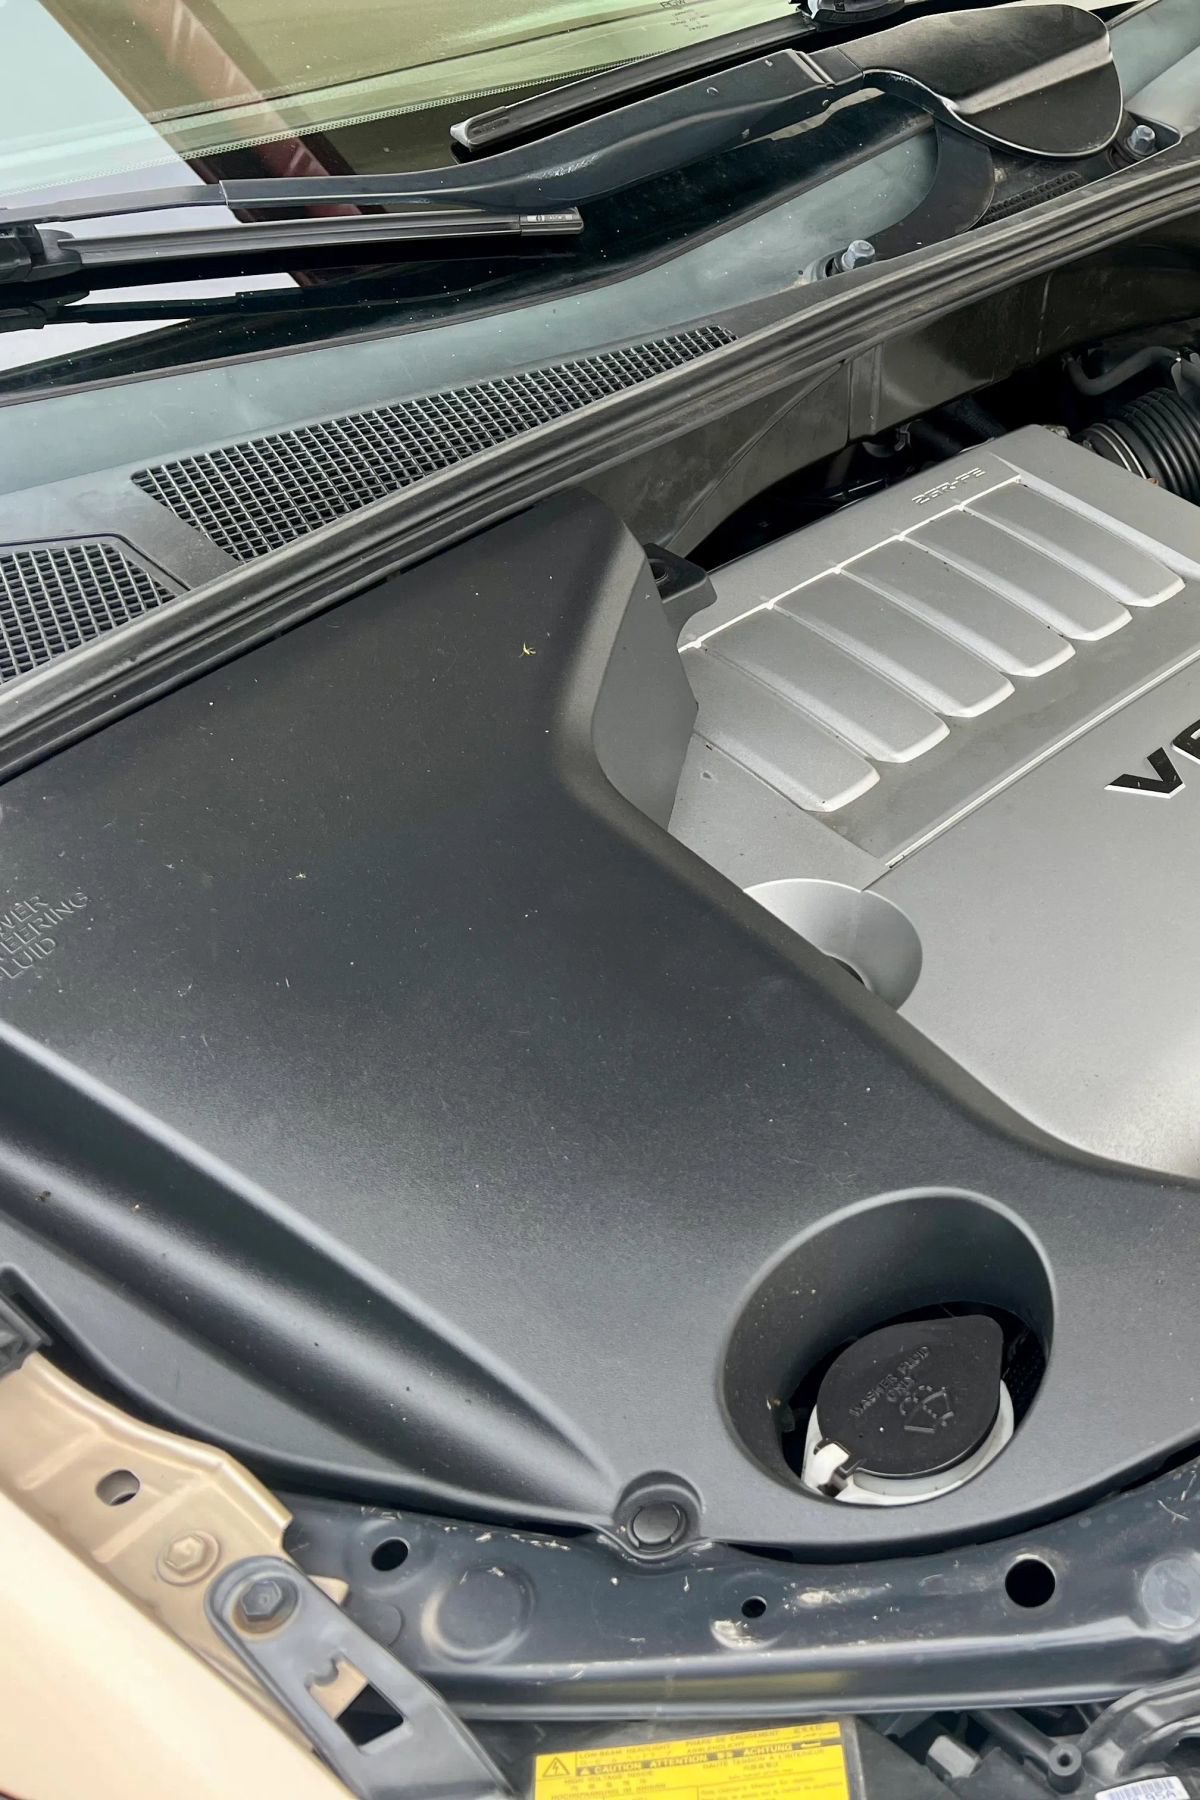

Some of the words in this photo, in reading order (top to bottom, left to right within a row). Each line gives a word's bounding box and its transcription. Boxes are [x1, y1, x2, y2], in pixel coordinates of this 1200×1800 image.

[0, 938, 56, 979] LUID
[594, 1761, 642, 1774] CAUTION
[650, 1753, 708, 1769] ATTENTION
[743, 1742, 793, 1756] ACHTUNG
